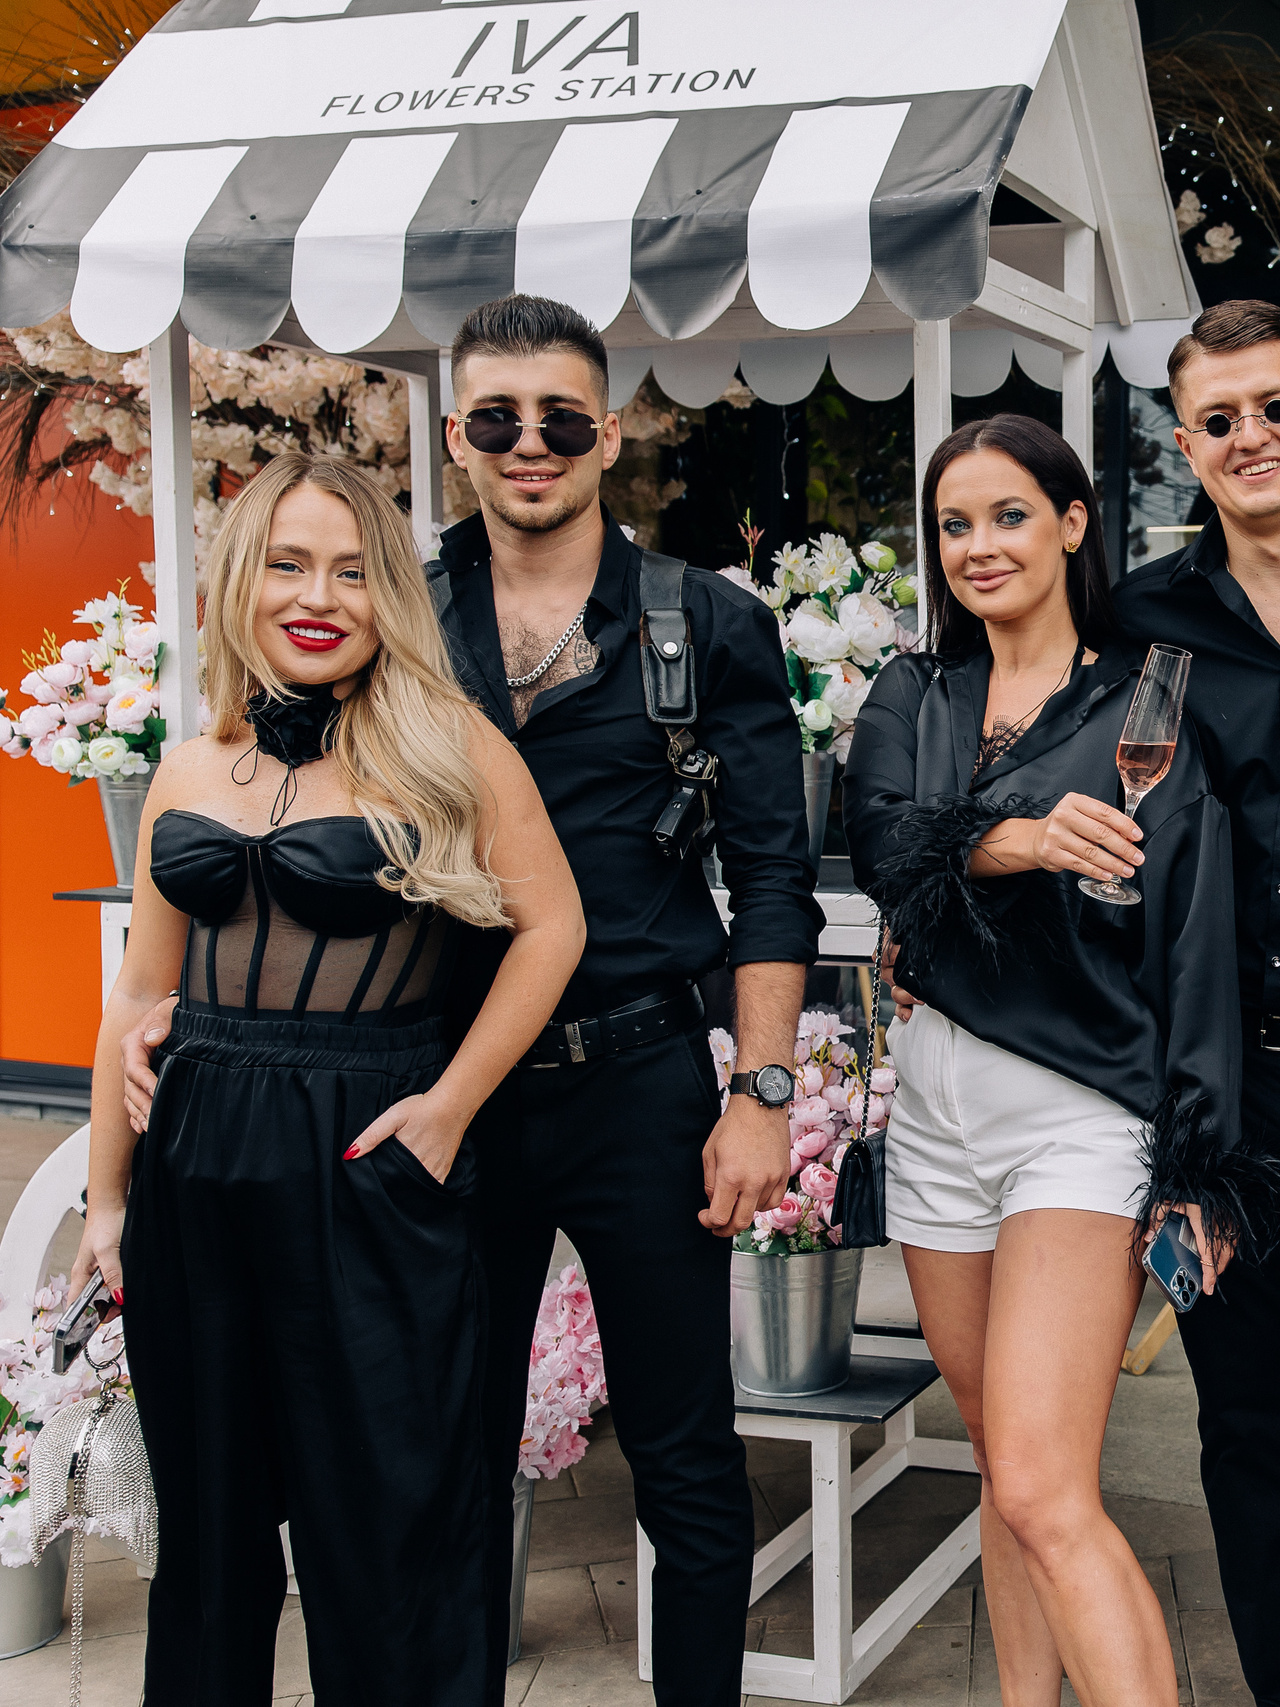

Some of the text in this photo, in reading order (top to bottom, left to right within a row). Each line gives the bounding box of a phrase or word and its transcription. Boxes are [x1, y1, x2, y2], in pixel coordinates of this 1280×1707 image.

[451, 11, 640, 79] IVA
[321, 67, 757, 117] FLOWERS STATION
